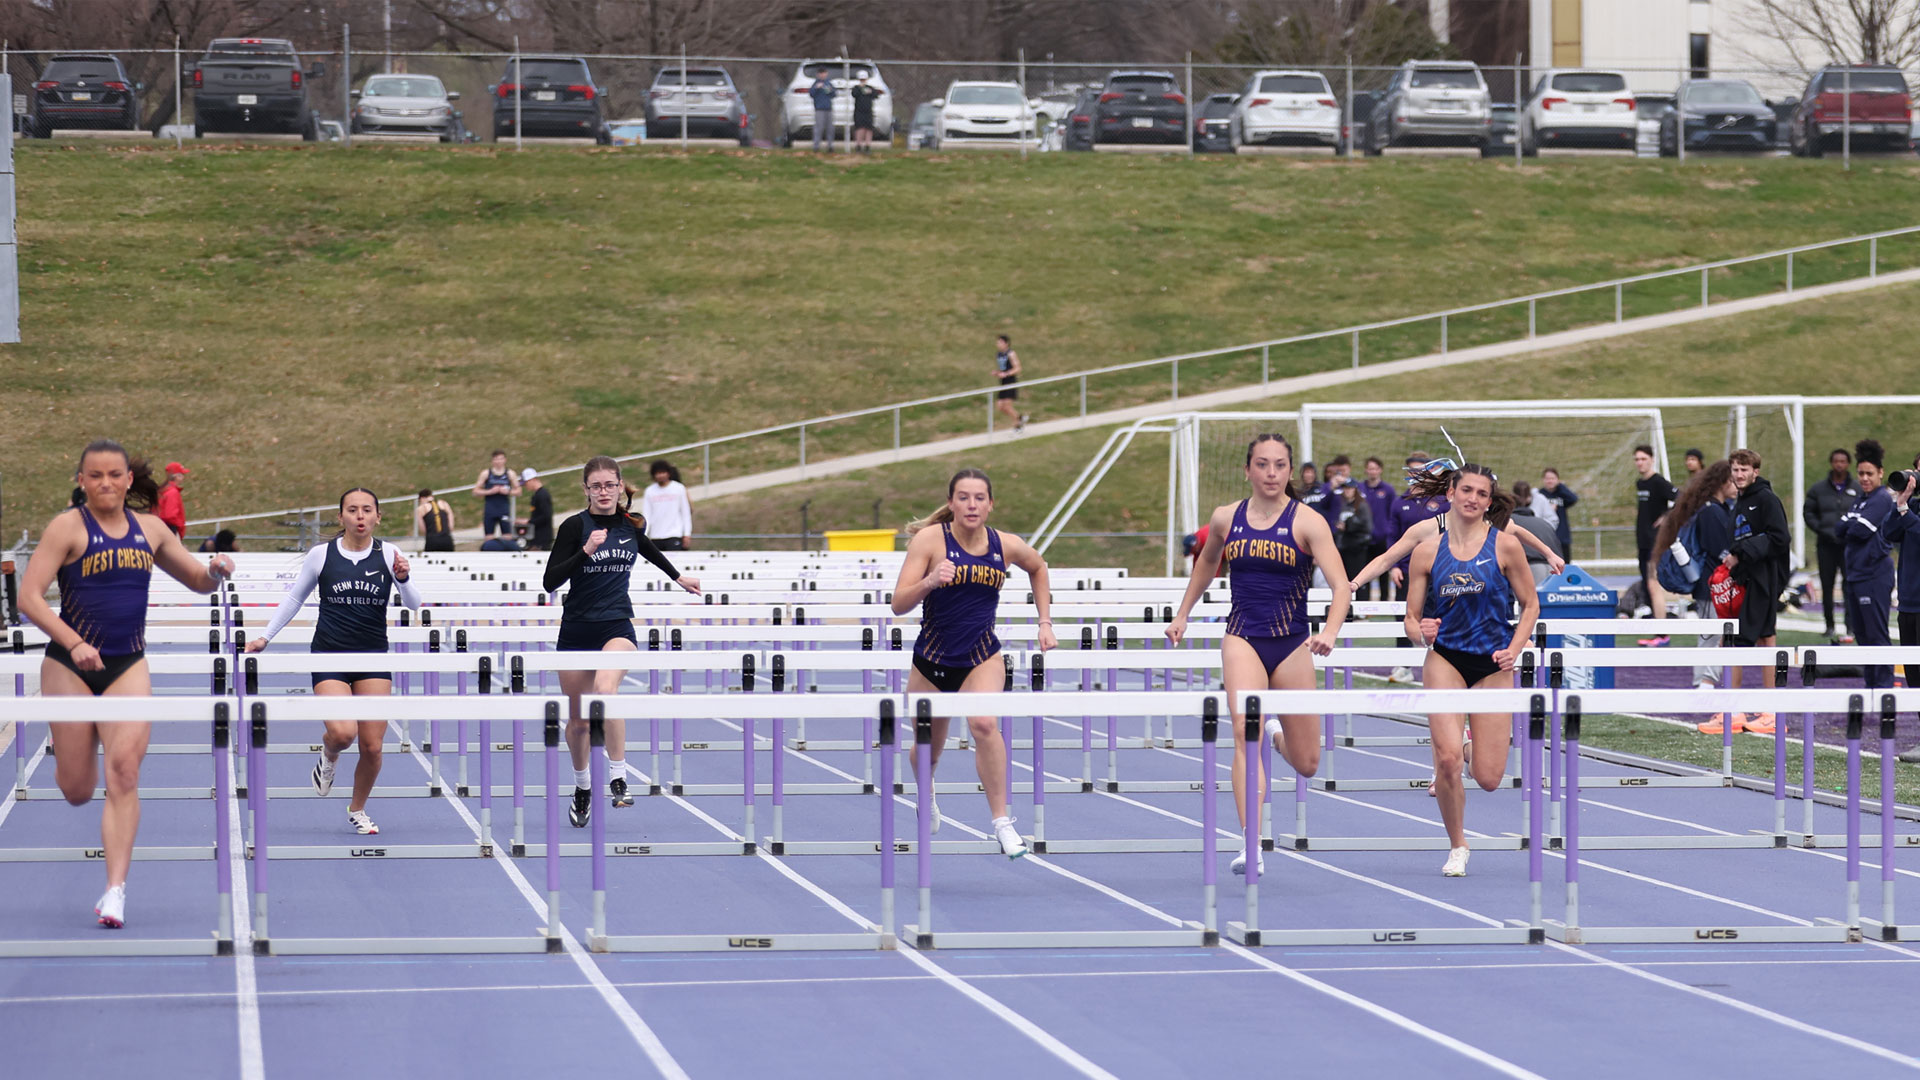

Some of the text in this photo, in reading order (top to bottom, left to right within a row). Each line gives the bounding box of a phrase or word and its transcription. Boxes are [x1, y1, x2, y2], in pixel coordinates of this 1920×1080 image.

[591, 548, 634, 562] PENN STATE
[1249, 539, 1296, 567] CHESTER
[82, 547, 154, 577] WEST CHESTE
[583, 566, 601, 574] TRACK
[332, 580, 380, 595] PENN STATE
[1441, 584, 1482, 596] LIGHTNING
[327, 596, 345, 604] TRACK
[353, 596, 371, 605] FIELD
[1410, 780, 1429, 788] UC
[1620, 778, 1648, 786] UCS
[85, 850, 106, 859] UC
[351, 849, 387, 857] UCS
[614, 846, 650, 854] UCS
[1373, 931, 1417, 942] UCS
[1696, 929, 1738, 939] UCS
[728, 938, 772, 948] UCS
